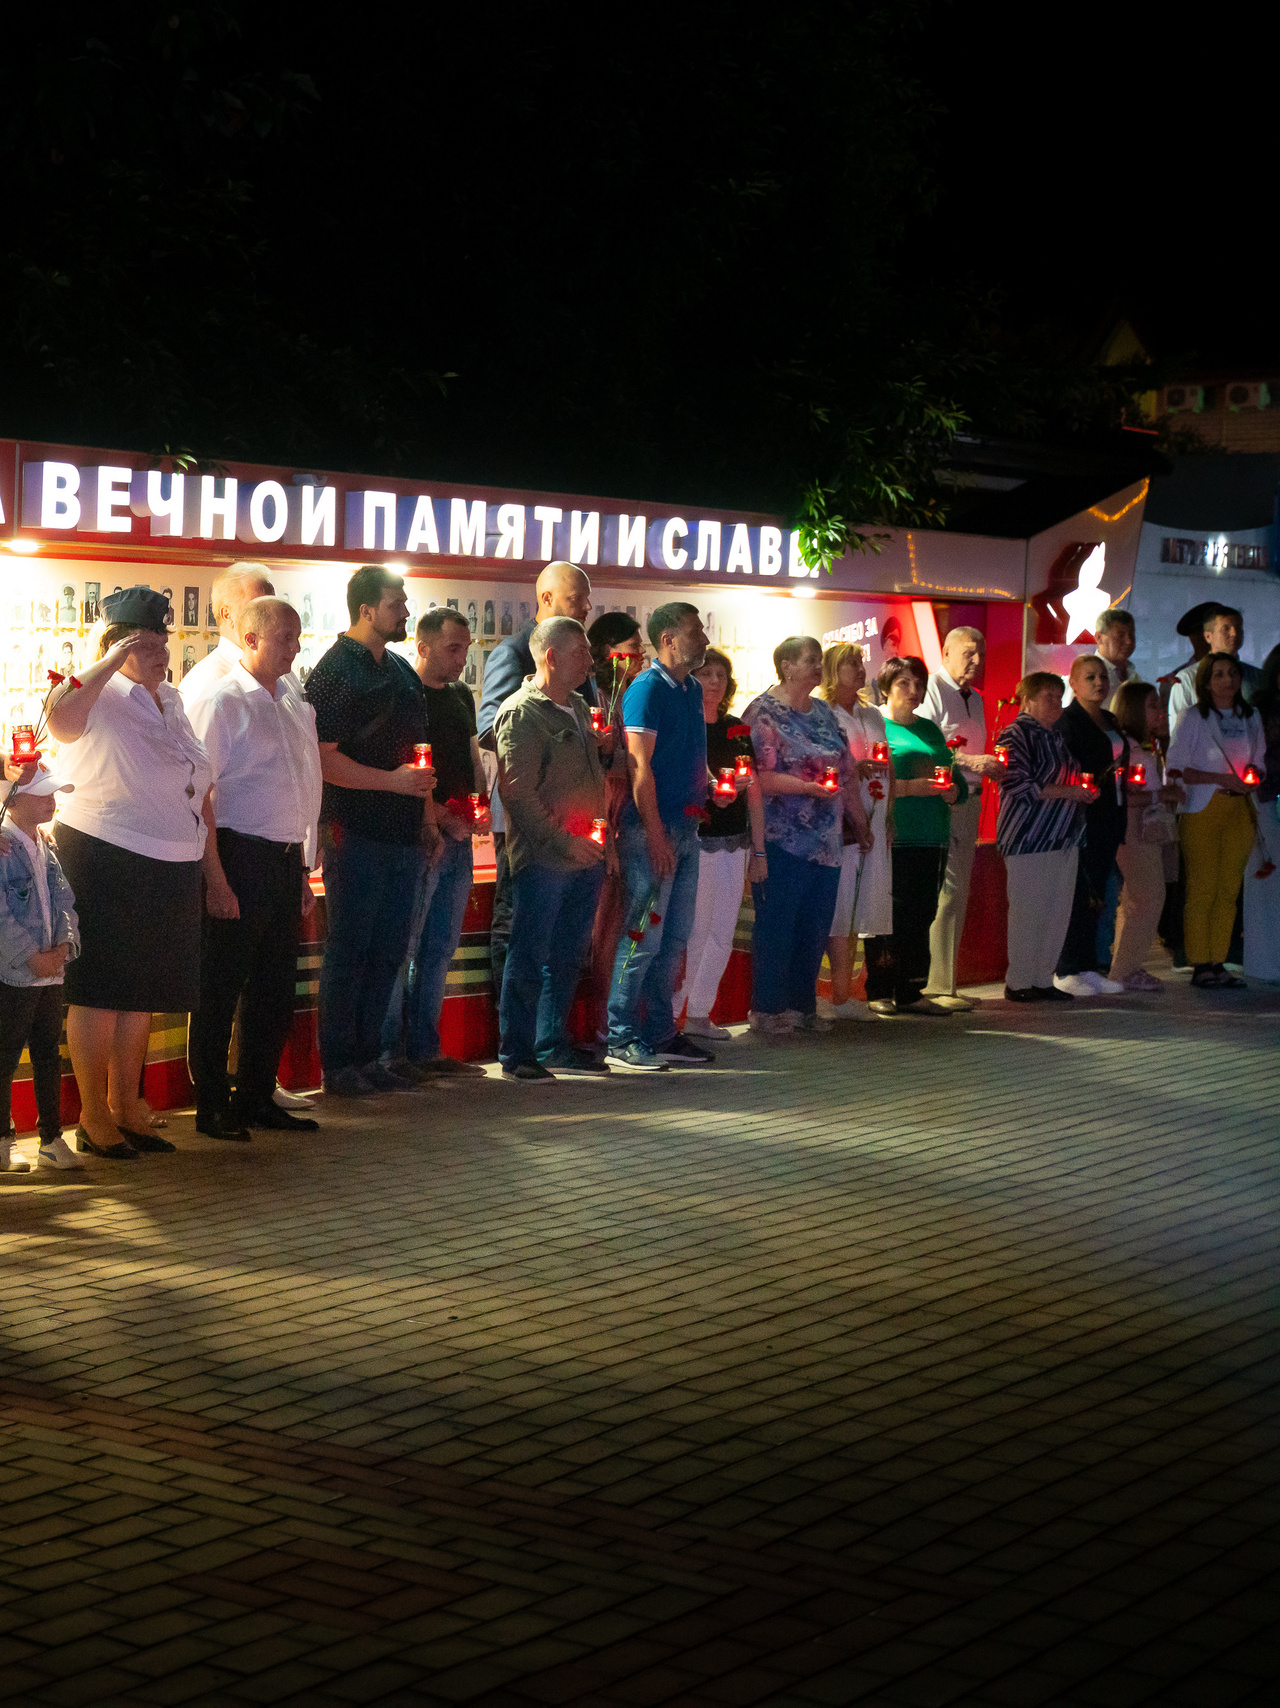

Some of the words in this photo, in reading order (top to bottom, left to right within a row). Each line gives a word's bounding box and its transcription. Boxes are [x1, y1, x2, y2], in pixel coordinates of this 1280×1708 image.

[40, 461, 336, 547] ВЕЧНОЙ
[362, 490, 601, 566] ПАМЯТИ
[618, 514, 646, 568] И
[865, 617, 878, 638] ЗА
